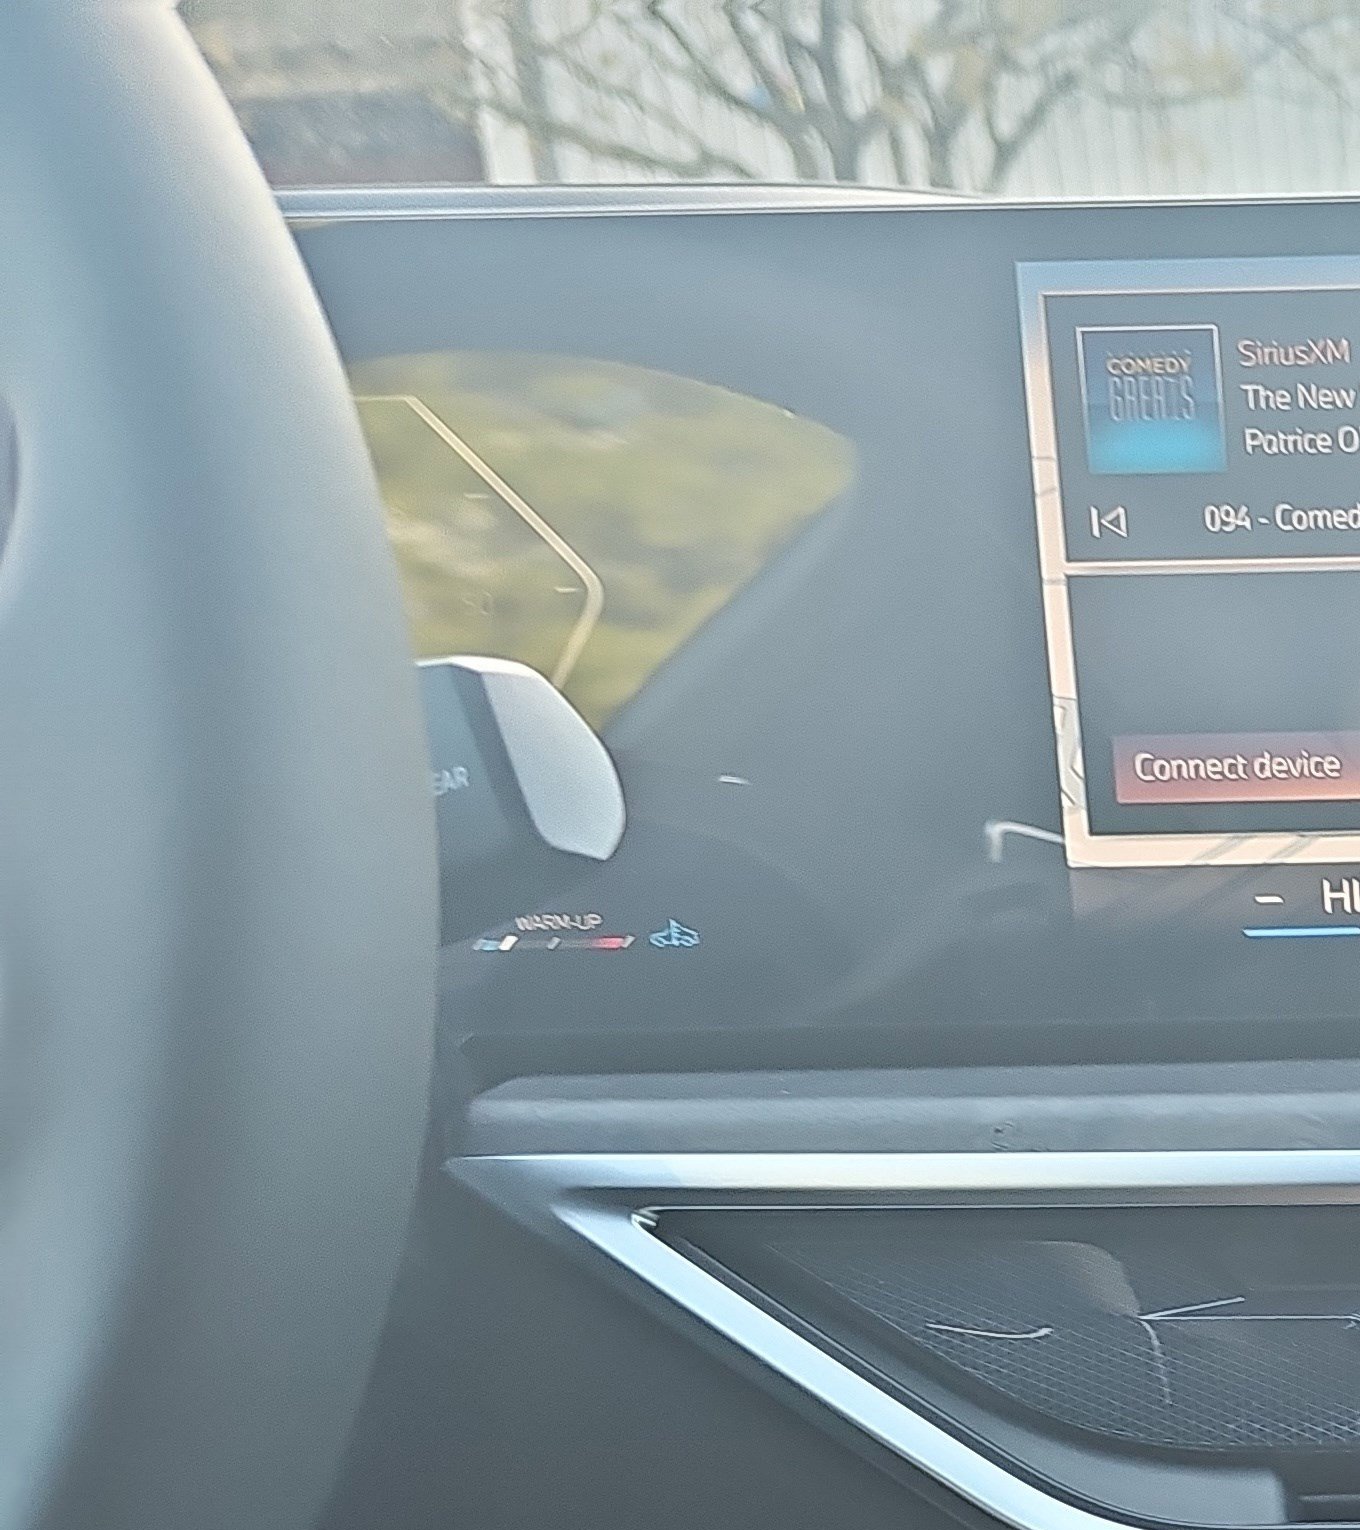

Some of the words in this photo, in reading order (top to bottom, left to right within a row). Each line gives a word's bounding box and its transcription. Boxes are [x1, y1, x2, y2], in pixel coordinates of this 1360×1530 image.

[1107, 356, 1191, 375] COMEDY
[1238, 338, 1350, 367] SiriusXM
[1109, 374, 1195, 421] GREATS
[1240, 382, 1292, 410] The
[1296, 382, 1357, 410] New
[1244, 426, 1333, 455] Patrice
[1204, 503, 1252, 532] 094
[1134, 752, 1249, 781] Connect
[1253, 750, 1341, 779] device
[432, 766, 470, 796] EAR
